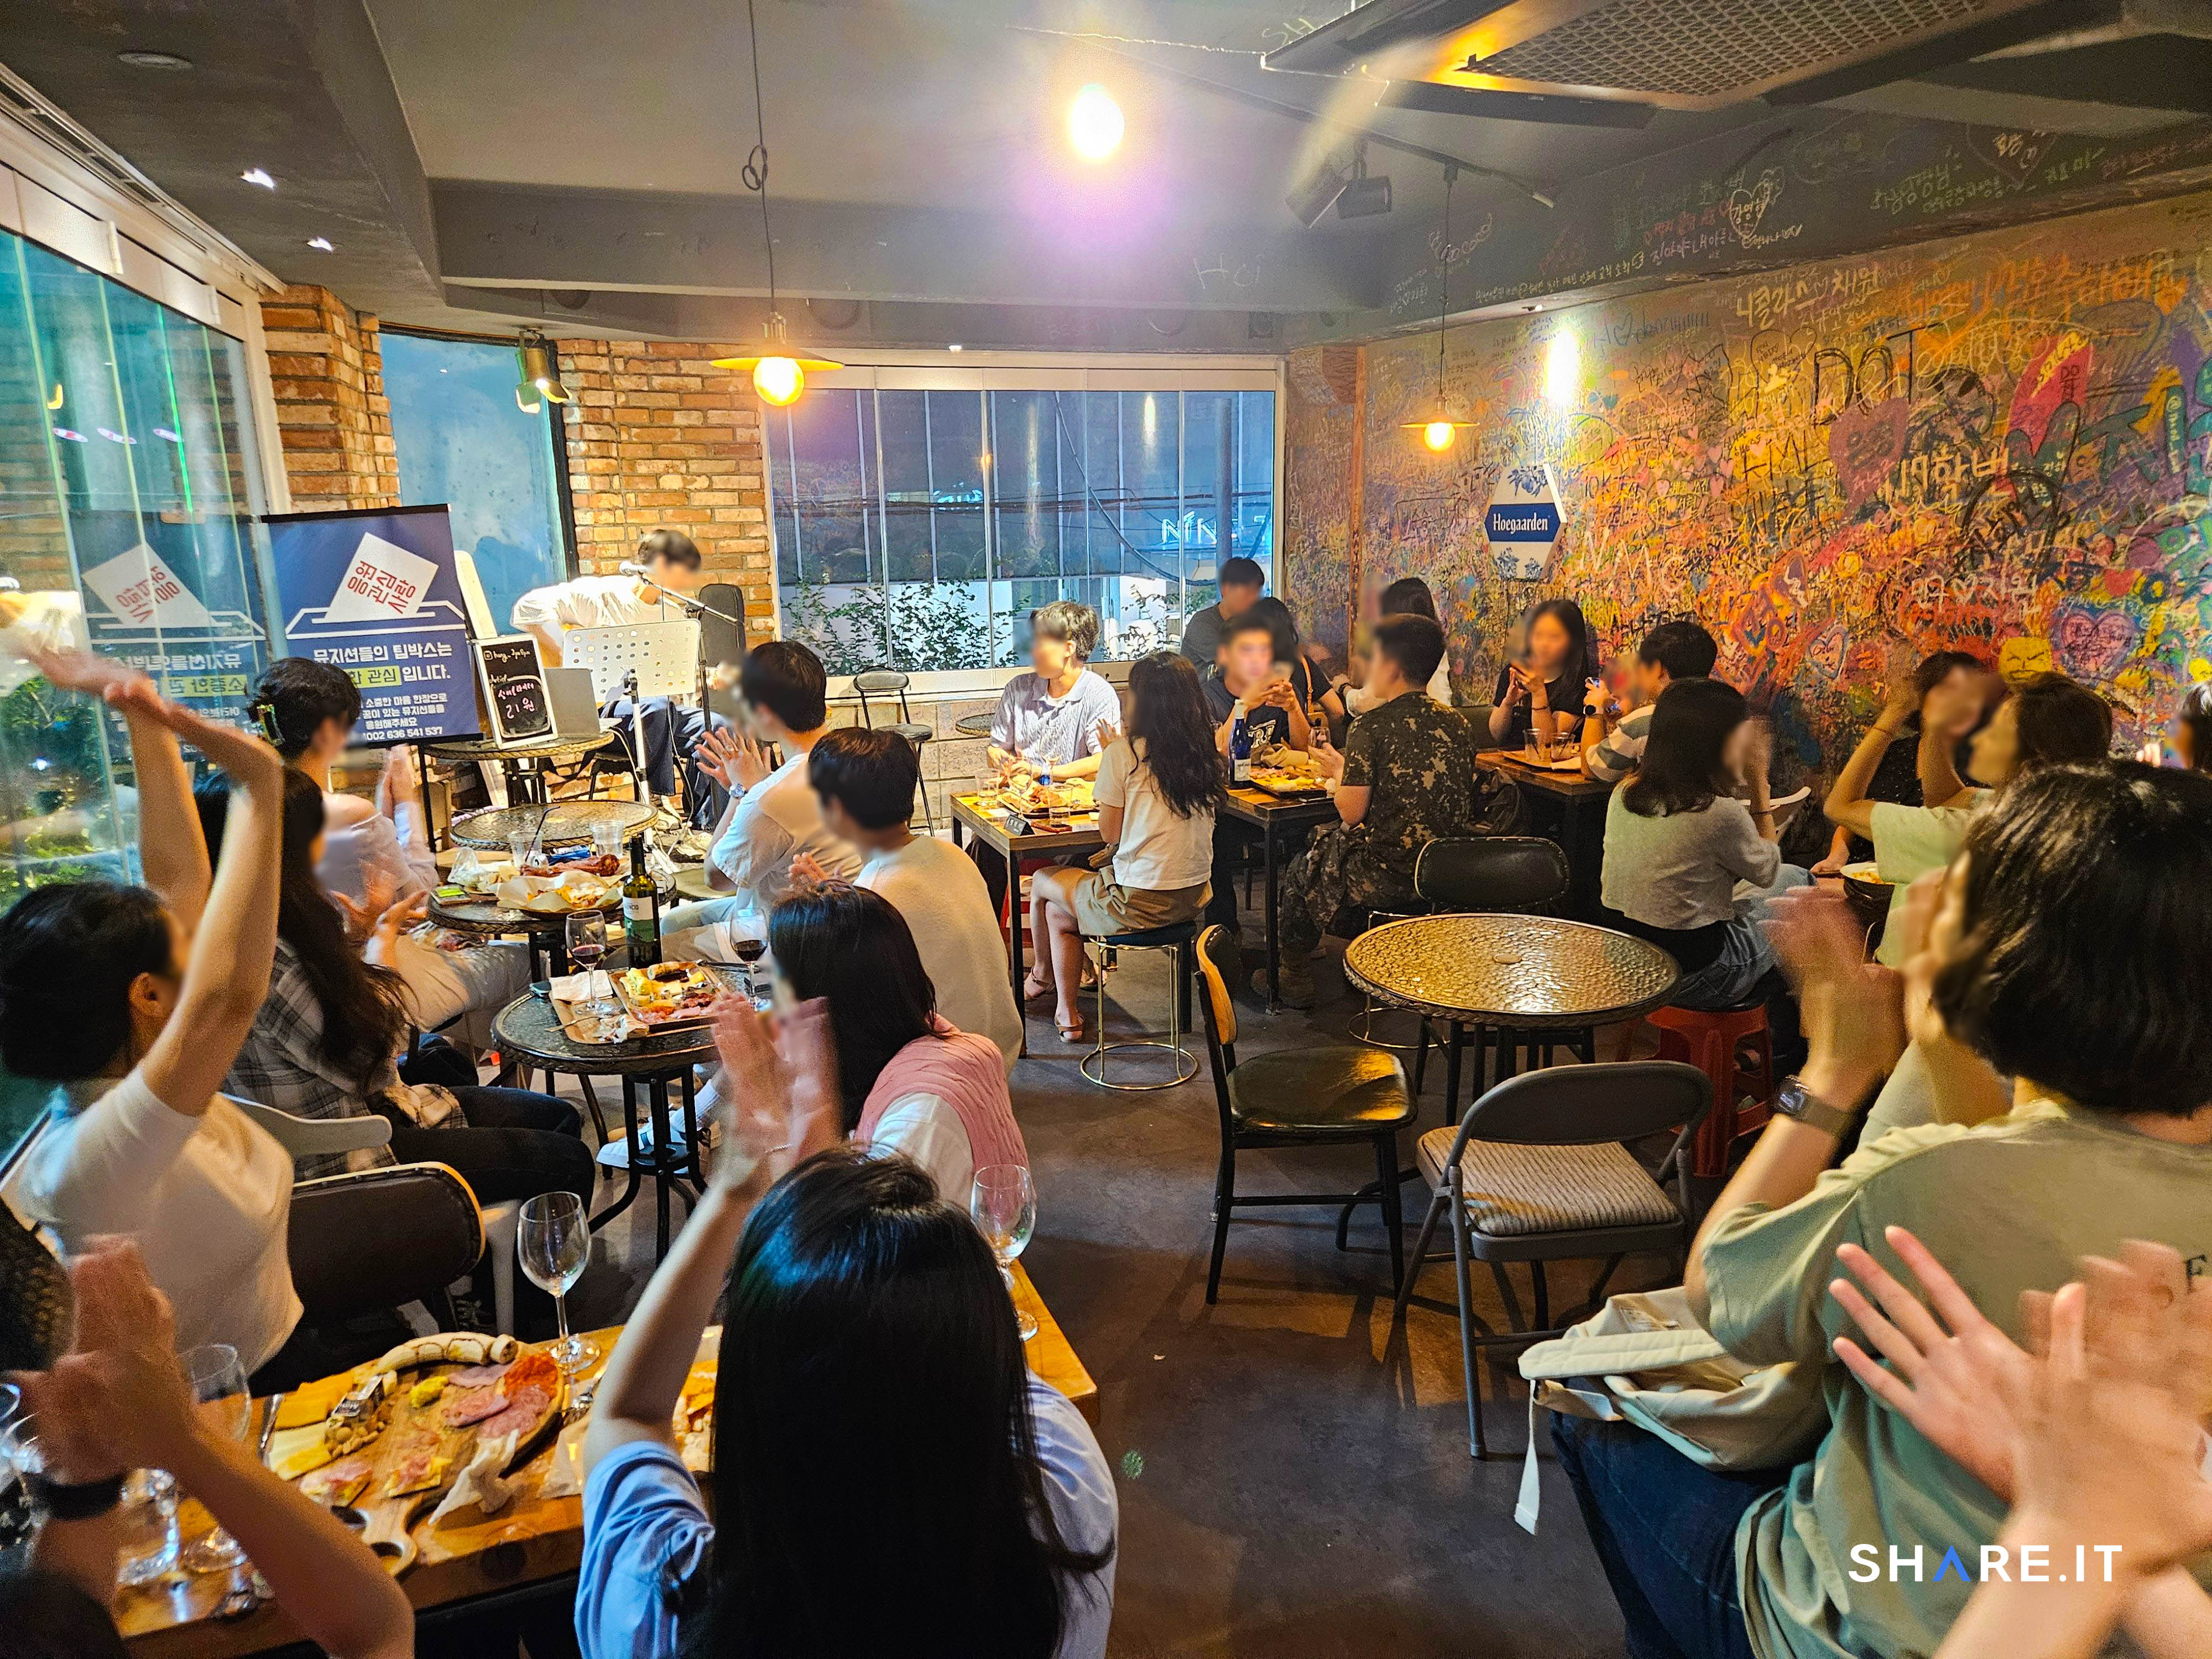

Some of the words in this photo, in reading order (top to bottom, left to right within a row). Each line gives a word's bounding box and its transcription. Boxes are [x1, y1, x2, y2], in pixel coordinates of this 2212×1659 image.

[1493, 512, 1548, 534] Hoegaarden
[348, 561, 377, 594] 응원
[367, 570, 398, 604] 관심
[388, 580, 416, 614] 사랑
[314, 645, 389, 664] 뮤지션들의
[392, 641, 452, 660] 팁박스는
[367, 669, 397, 684] 관심
[402, 664, 451, 682] 입니다.
[366, 698, 392, 708] 소중한
[394, 696, 411, 706] 마음
[413, 693, 448, 704] 한장으로
[362, 709, 380, 719] 꿈이
[382, 707, 400, 717] 있는
[402, 704, 445, 716] 뮤지션들을
[365, 717, 418, 730] 응원해주세요
[387, 729, 405, 739] 636
[407, 728, 424, 738] 541
[425, 726, 443, 736] 537
